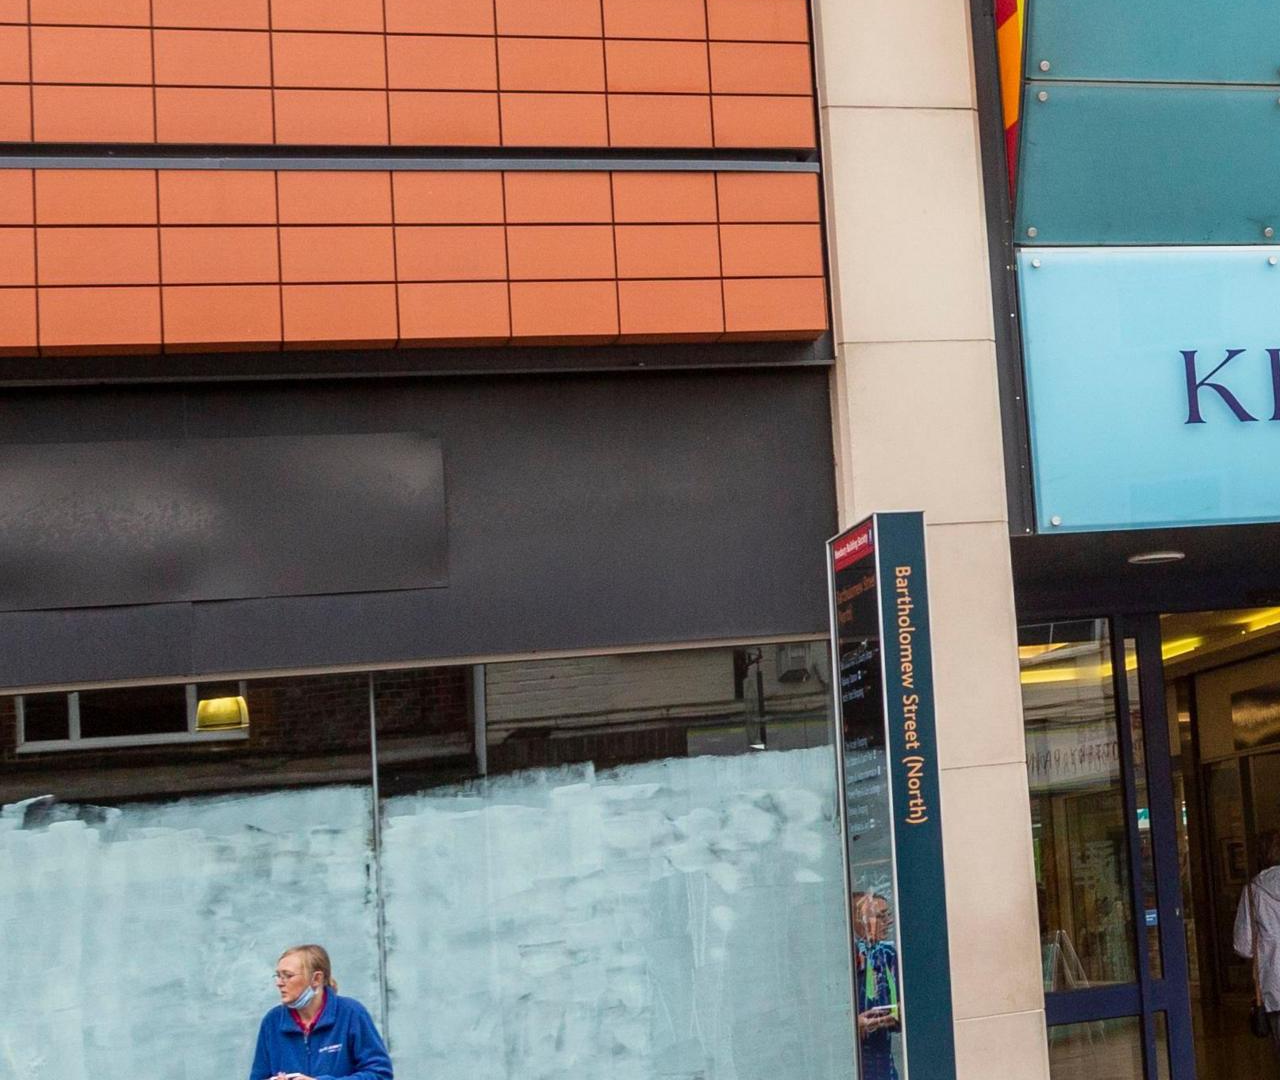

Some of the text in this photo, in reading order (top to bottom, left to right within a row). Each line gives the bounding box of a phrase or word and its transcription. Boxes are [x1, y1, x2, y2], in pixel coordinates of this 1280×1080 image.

[896, 565, 928, 824] Bartholomew Street (North)
